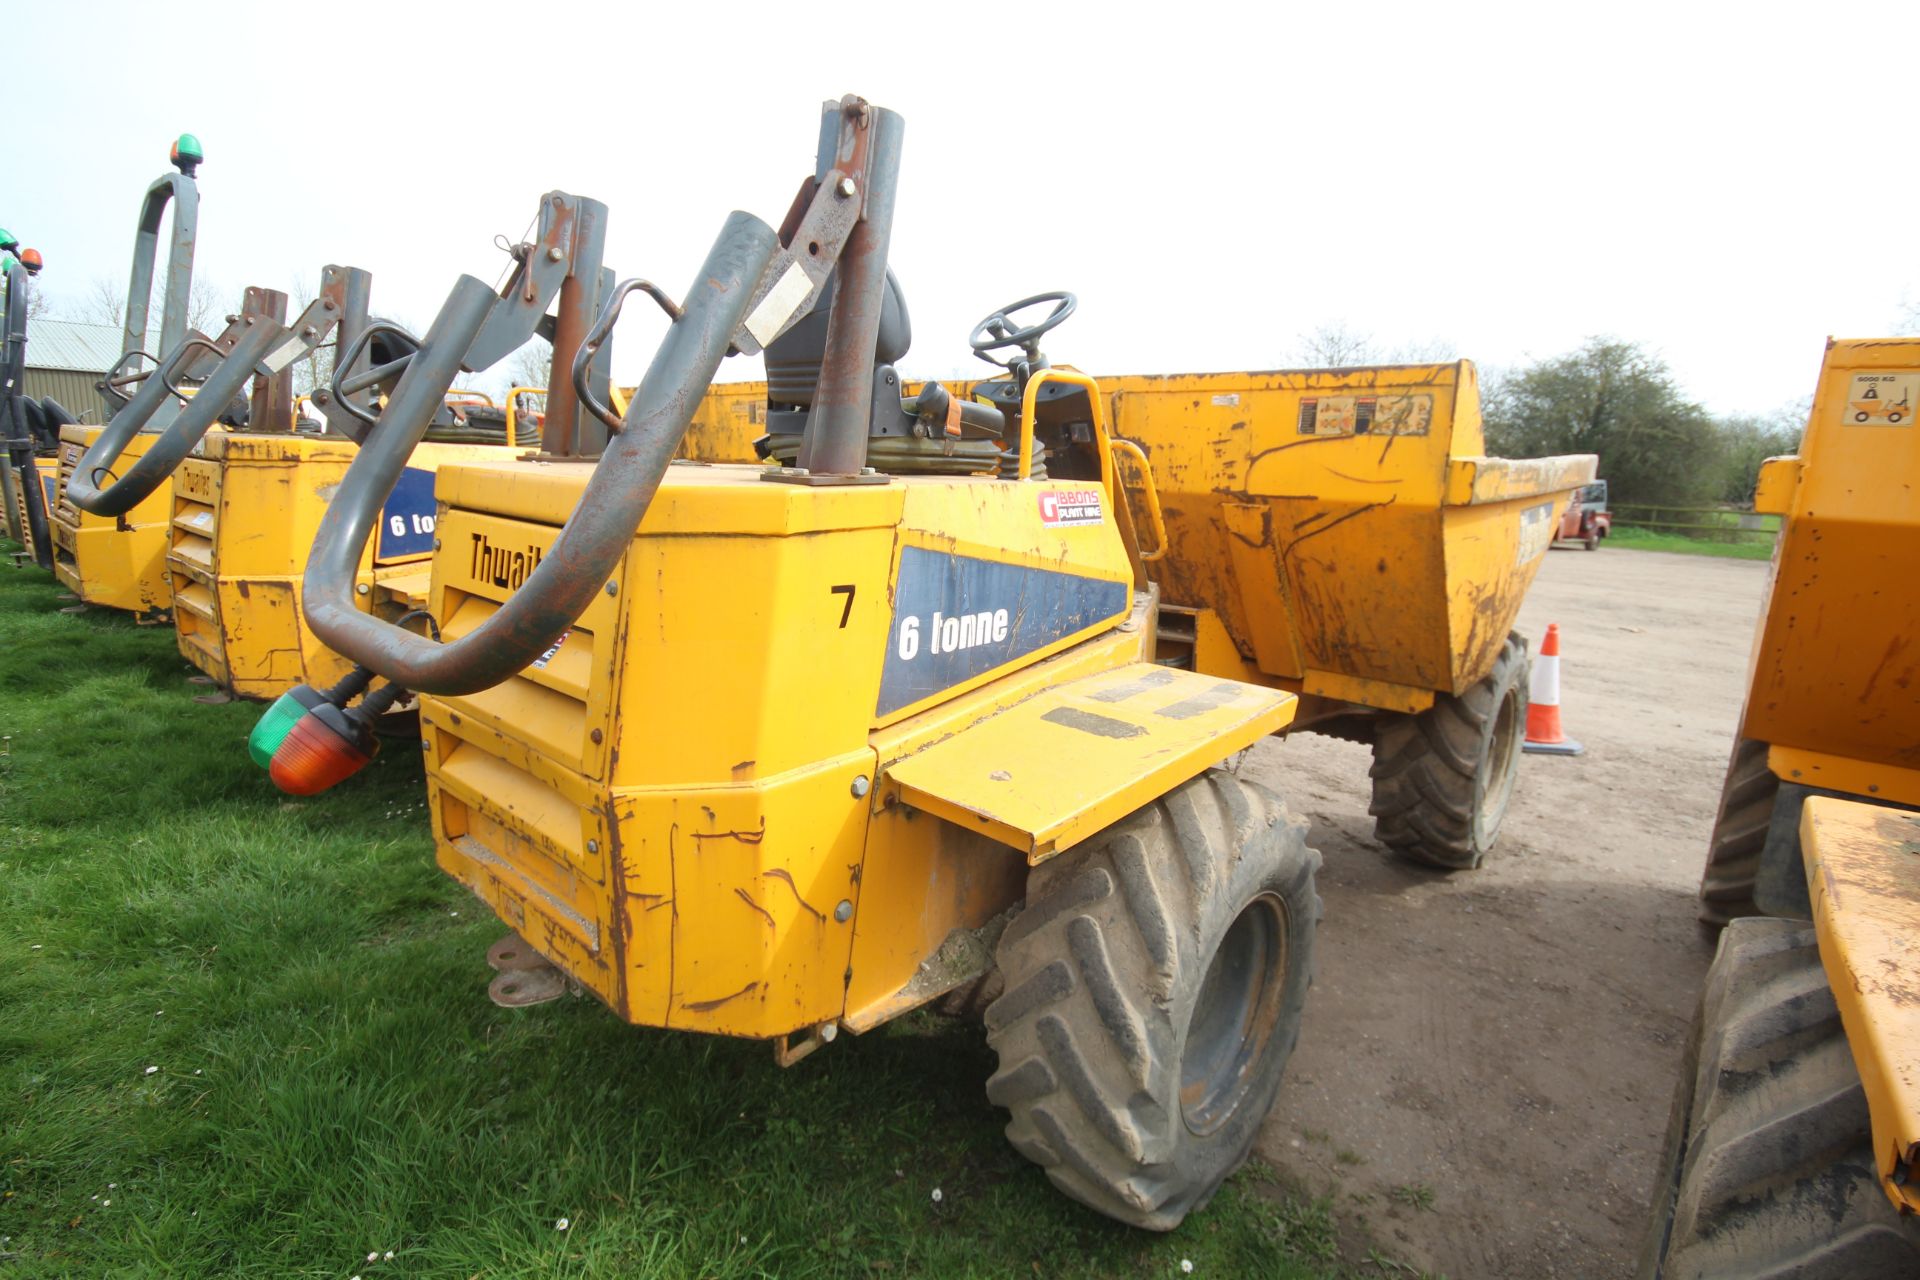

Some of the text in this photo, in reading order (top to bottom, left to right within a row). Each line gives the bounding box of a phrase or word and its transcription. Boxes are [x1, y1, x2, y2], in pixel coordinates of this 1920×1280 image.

[1038, 490, 1098, 522] GIBBONS
[1060, 507, 1083, 519] PLANT
[390, 514, 437, 537] 6 to
[831, 584, 856, 629] 7
[898, 608, 1009, 661] 6 tonne
